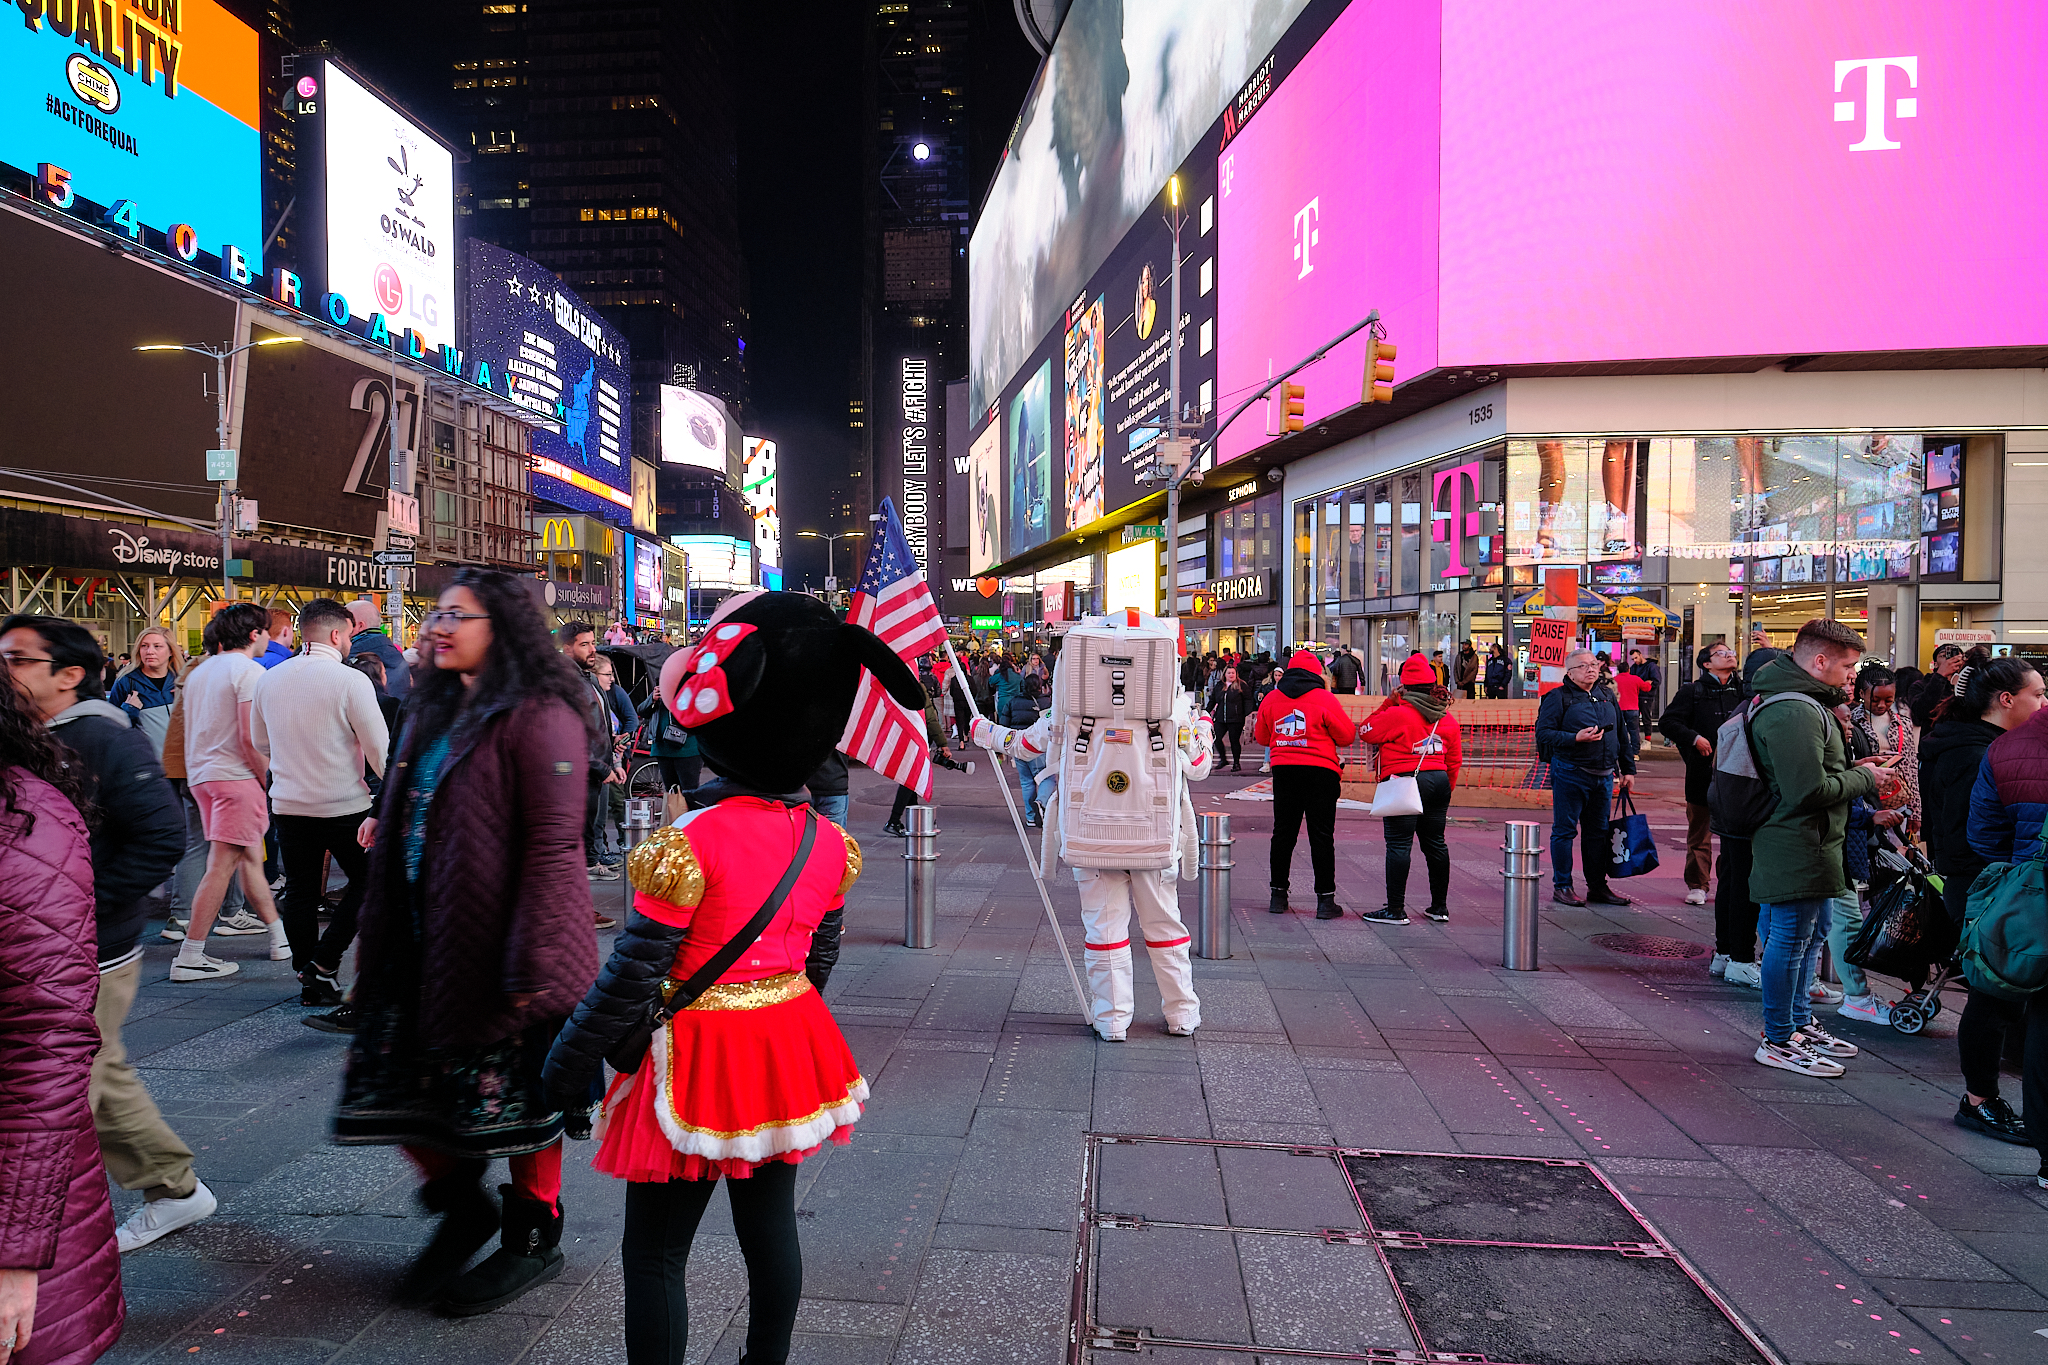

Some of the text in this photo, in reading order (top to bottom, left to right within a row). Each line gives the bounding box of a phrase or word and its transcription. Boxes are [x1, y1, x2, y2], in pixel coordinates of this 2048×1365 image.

[2, 0, 182, 100] QUALITY
[77, 73, 110, 97] CHIME
[1238, 53, 1275, 109] MARRIOTT
[298, 102, 317, 115] LG
[1238, 78, 1270, 125] MARQUIS
[46, 93, 139, 157] #ACTFOREQUAL
[380, 213, 436, 258] OSWALD
[409, 283, 438, 327] LG
[222, 245, 518, 398] BROADWAY
[554, 290, 580, 340] GIRLS
[580, 313, 602, 357] EAST
[902, 357, 928, 424] #FIGHT
[1468, 404, 1493, 426] 1535
[903, 426, 928, 476] LET'S
[1228, 480, 1257, 502] SEPHORA
[1134, 528, 1143, 537] W
[1145, 527, 1157, 537] 46
[108, 528, 219, 575] Disney store
[327, 556, 391, 591] FOREVE
[951, 578, 977, 592] WE
[557, 585, 603, 607] sunglass hut
[1211, 574, 1262, 602] SEPHORA
[1207, 597, 1216, 613] 5
[975, 619, 996, 627] NEW
[1534, 622, 1565, 640] RAISE
[1619, 615, 1663, 624] SABRETT
[1940, 632, 1992, 642] DAILY COMEDY SHOW
[1532, 644, 1563, 662] PLOW
[1276, 738, 1308, 748] TOPVIEW
